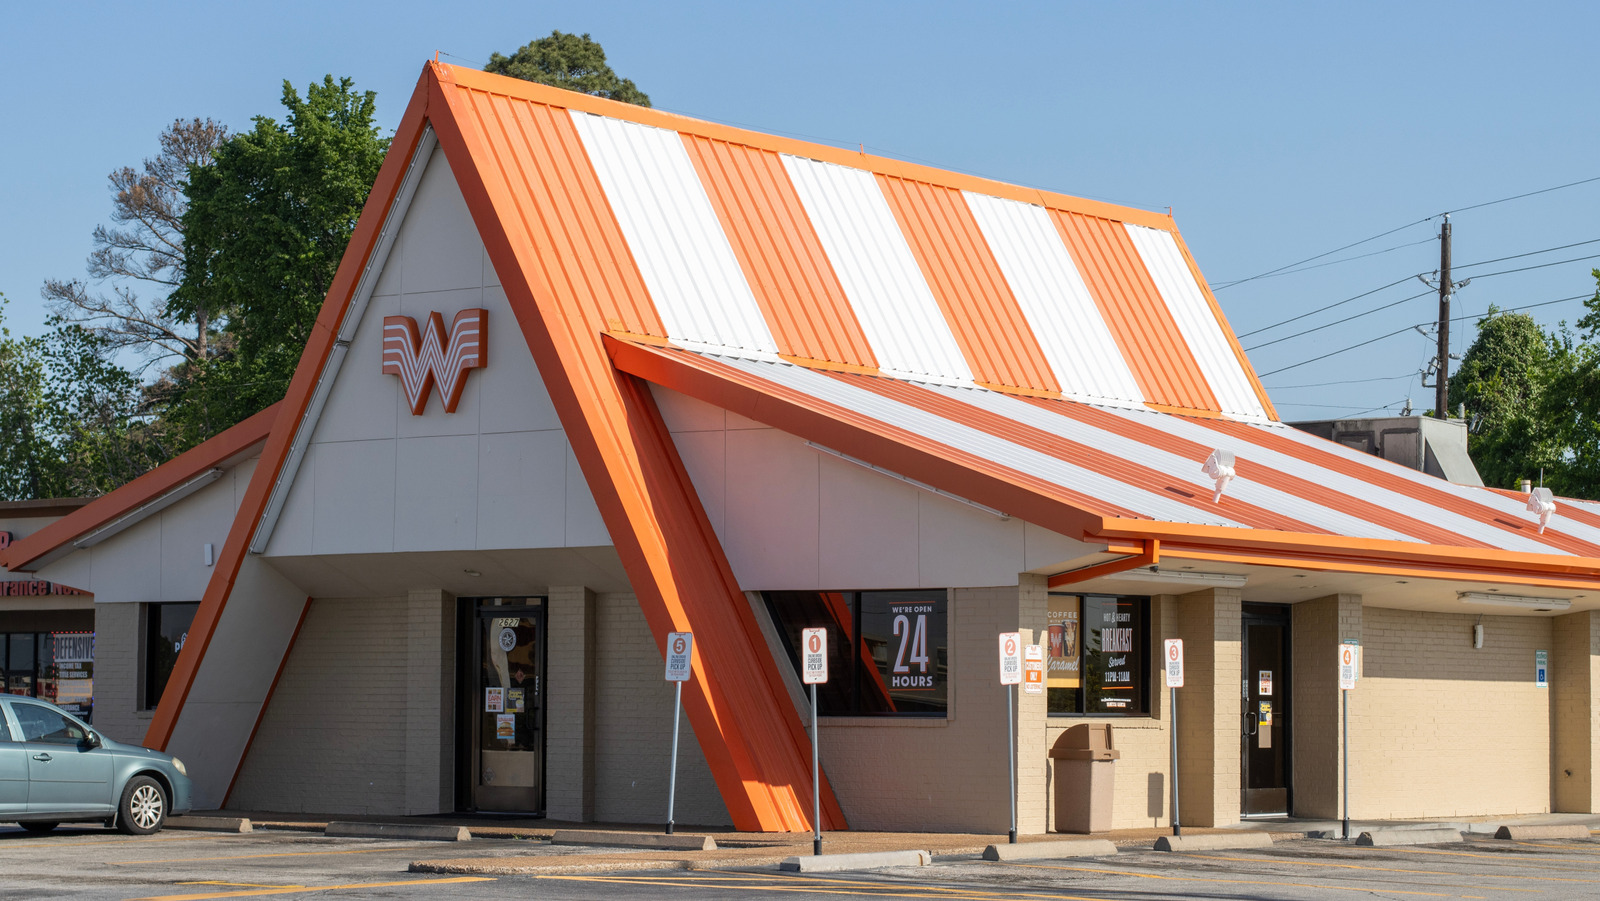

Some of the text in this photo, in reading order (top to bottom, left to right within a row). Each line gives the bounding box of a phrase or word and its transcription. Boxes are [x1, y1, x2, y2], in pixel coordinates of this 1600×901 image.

[0, 580, 51, 596] rance
[676, 640, 683, 652] 5
[893, 614, 930, 674] 24
[1102, 628, 1133, 652] BREAKFAST
[55, 636, 94, 660] DEFENSIVE
[1007, 641, 1014, 654] 2
[1171, 647, 1177, 659] 3
[1108, 655, 1126, 668] Served
[1344, 651, 1350, 663] 4
[892, 676, 933, 687] HOURS
